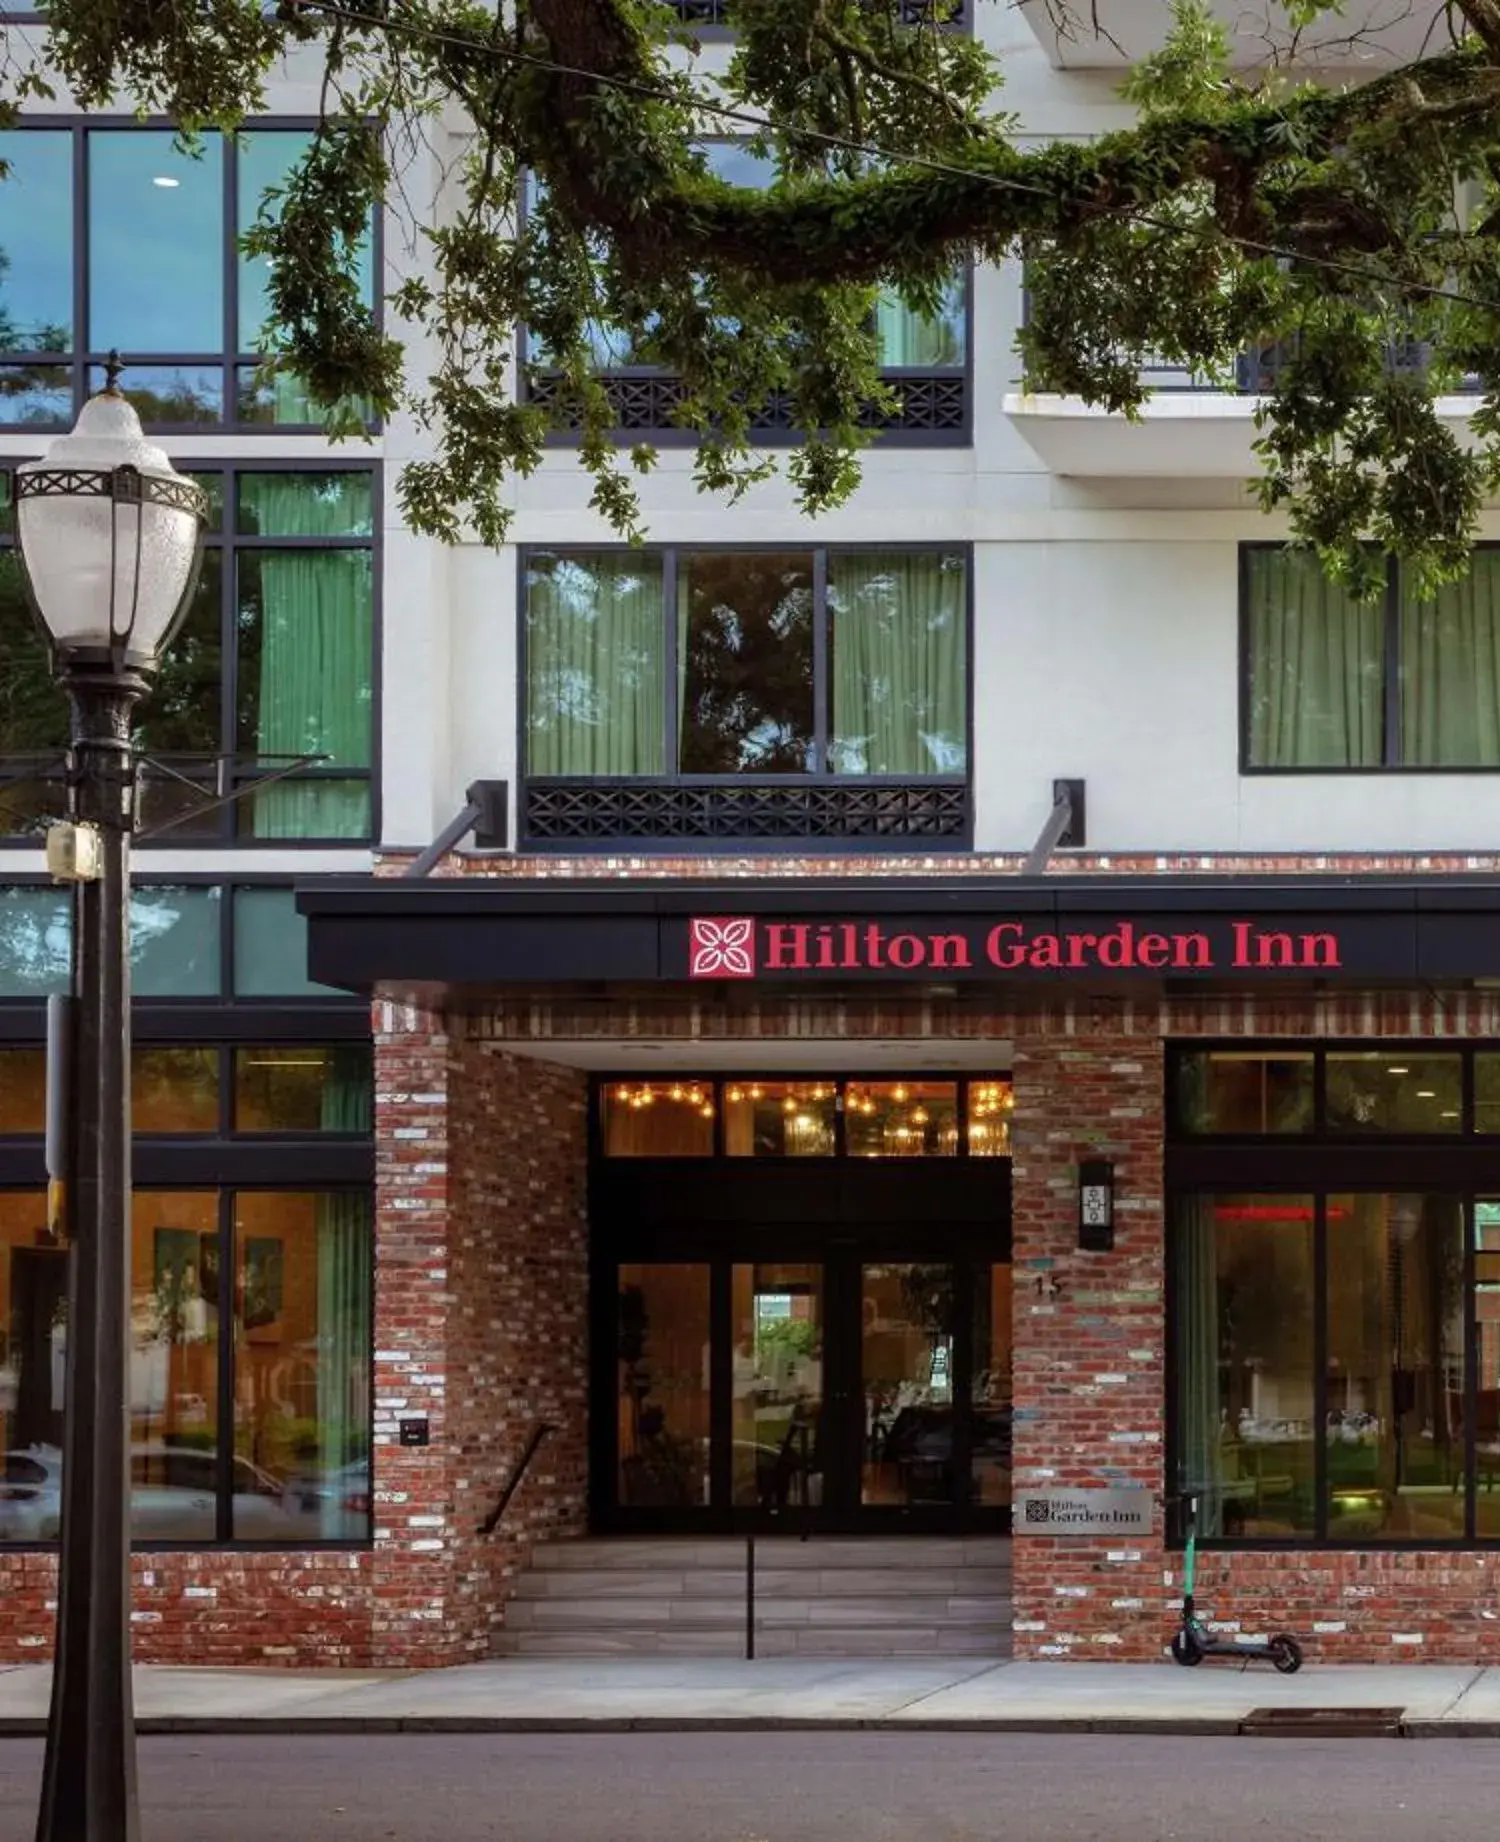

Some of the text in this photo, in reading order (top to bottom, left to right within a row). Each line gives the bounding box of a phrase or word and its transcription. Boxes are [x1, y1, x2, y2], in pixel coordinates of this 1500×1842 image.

[763, 921, 1343, 968] Hilton Garden Inn
[1050, 1509, 1141, 1522] Garden Inn
